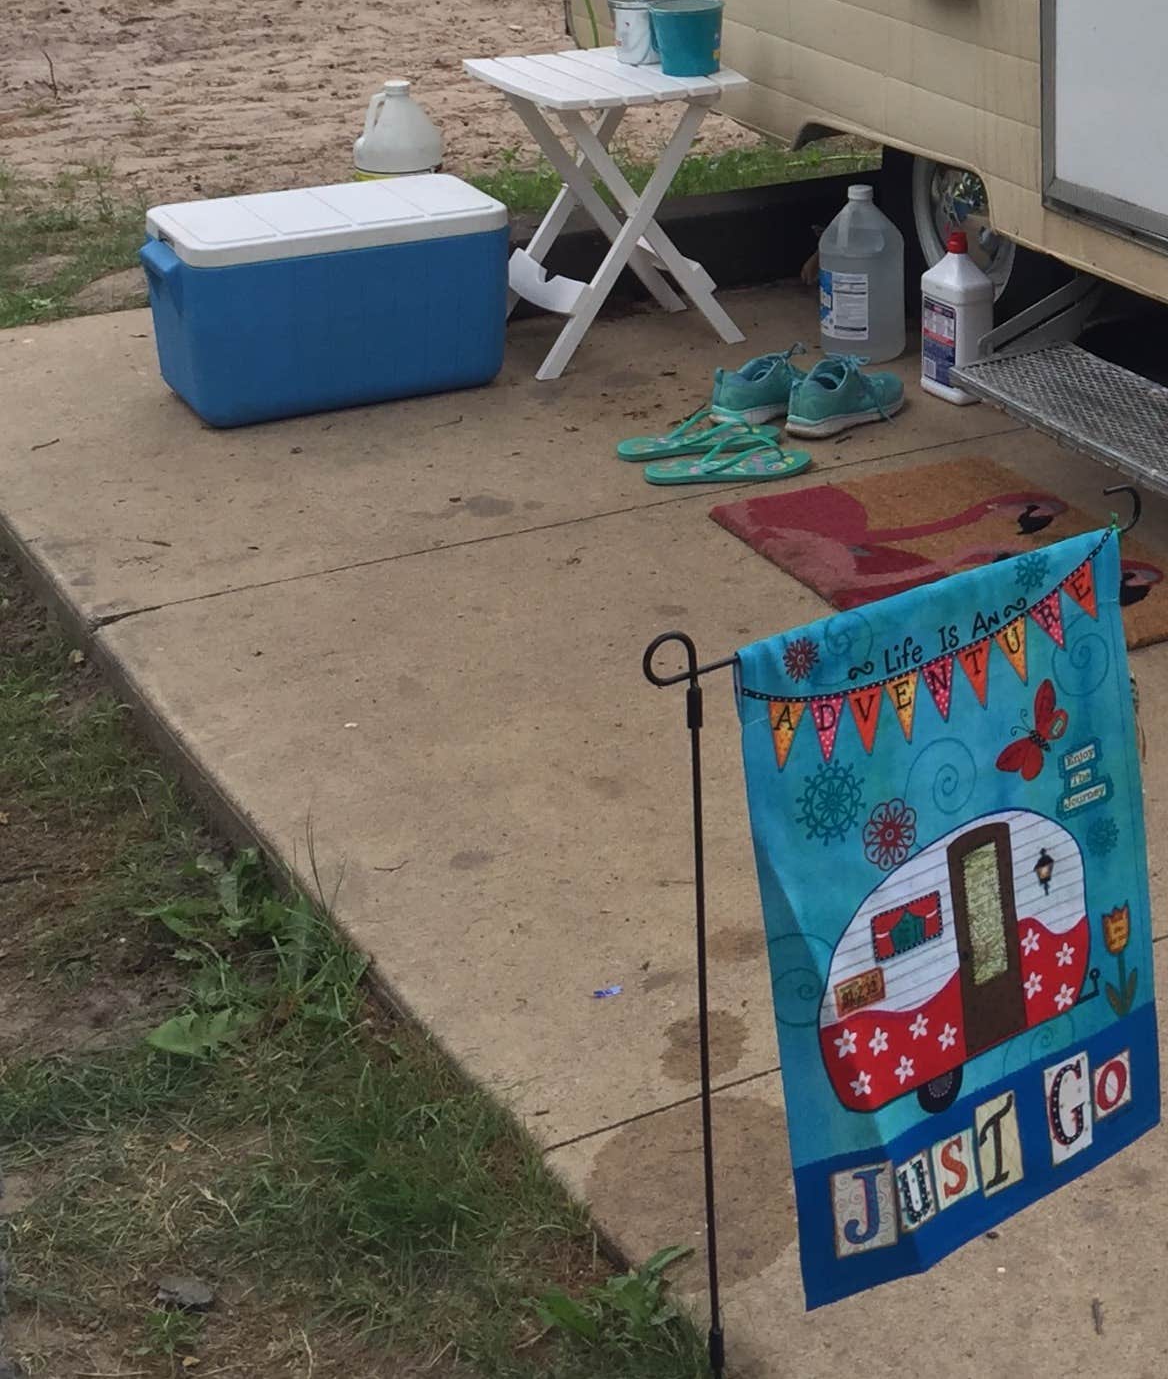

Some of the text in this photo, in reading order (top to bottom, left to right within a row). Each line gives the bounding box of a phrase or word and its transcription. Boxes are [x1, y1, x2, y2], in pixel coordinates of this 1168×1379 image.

[772, 570, 1094, 731] ADVENTURE
[884, 635, 924, 674] Life
[1066, 748, 1094, 766] Enjoy
[1072, 771, 1090, 785] The
[1064, 786, 1104, 809] Journey
